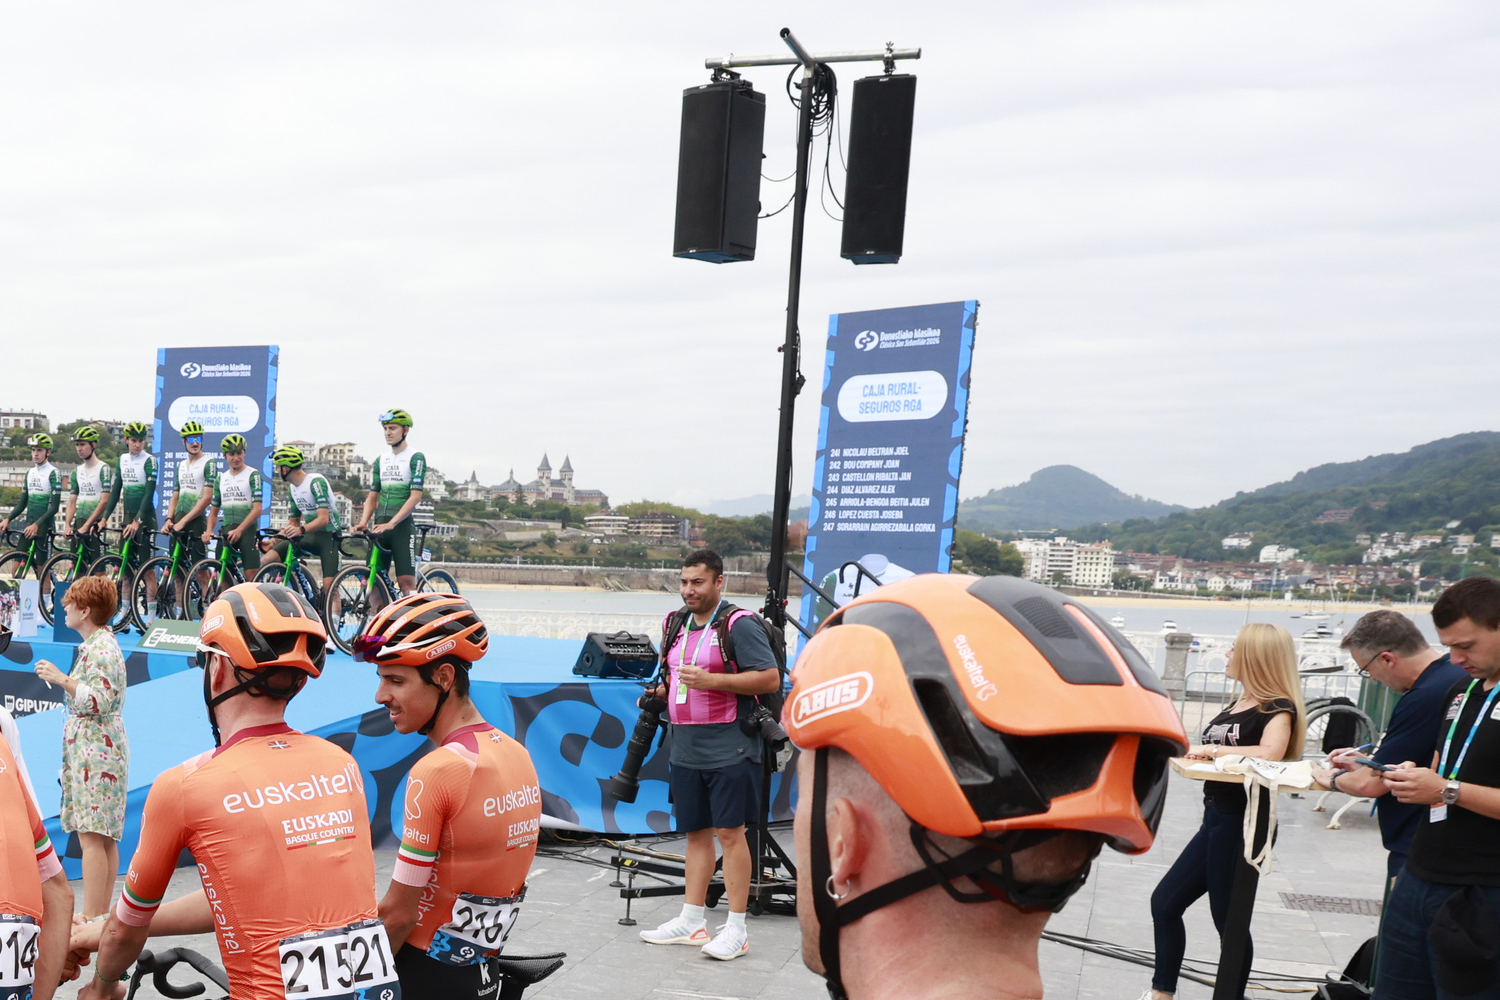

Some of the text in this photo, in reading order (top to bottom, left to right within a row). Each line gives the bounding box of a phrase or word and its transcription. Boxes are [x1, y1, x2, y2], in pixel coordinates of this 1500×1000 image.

[862, 385, 885, 397] CAJA
[189, 403, 209, 414] CAJA
[859, 399, 922, 414] SEGUROS RGA
[223, 416, 240, 427] RGA
[830, 446, 910, 457] 241 NICOLAU BELTRAN JOEL
[164, 461, 175, 469] 242
[829, 461, 841, 469] 242
[843, 460, 856, 469] BOU
[884, 459, 900, 468] JOAN
[163, 480, 174, 488] 244
[828, 473, 840, 482] 243
[899, 472, 912, 481] JAN
[827, 485, 896, 494] 244 DIAZ ALVAREZ ALEX
[825, 498, 837, 507] 245
[909, 497, 930, 507] JULEN
[824, 510, 903, 519] 246 LOPEZ CUESTA JOSEBA
[823, 523, 835, 532] 247
[914, 523, 936, 532] GORKA
[202, 617, 221, 634] ABUS
[429, 642, 454, 659] ABUS
[952, 634, 989, 692] euskaltel
[798, 680, 861, 720] ABUS
[223, 767, 354, 814] euskaltel
[483, 781, 541, 818] euskaltel
[281, 808, 354, 834] EUSKADI
[285, 825, 355, 846] BASQUE COUNTRY
[198, 862, 246, 955] euskaltel
[449, 905, 504, 944] 216
[350, 934, 391, 982] 21
[281, 942, 352, 994] 215
